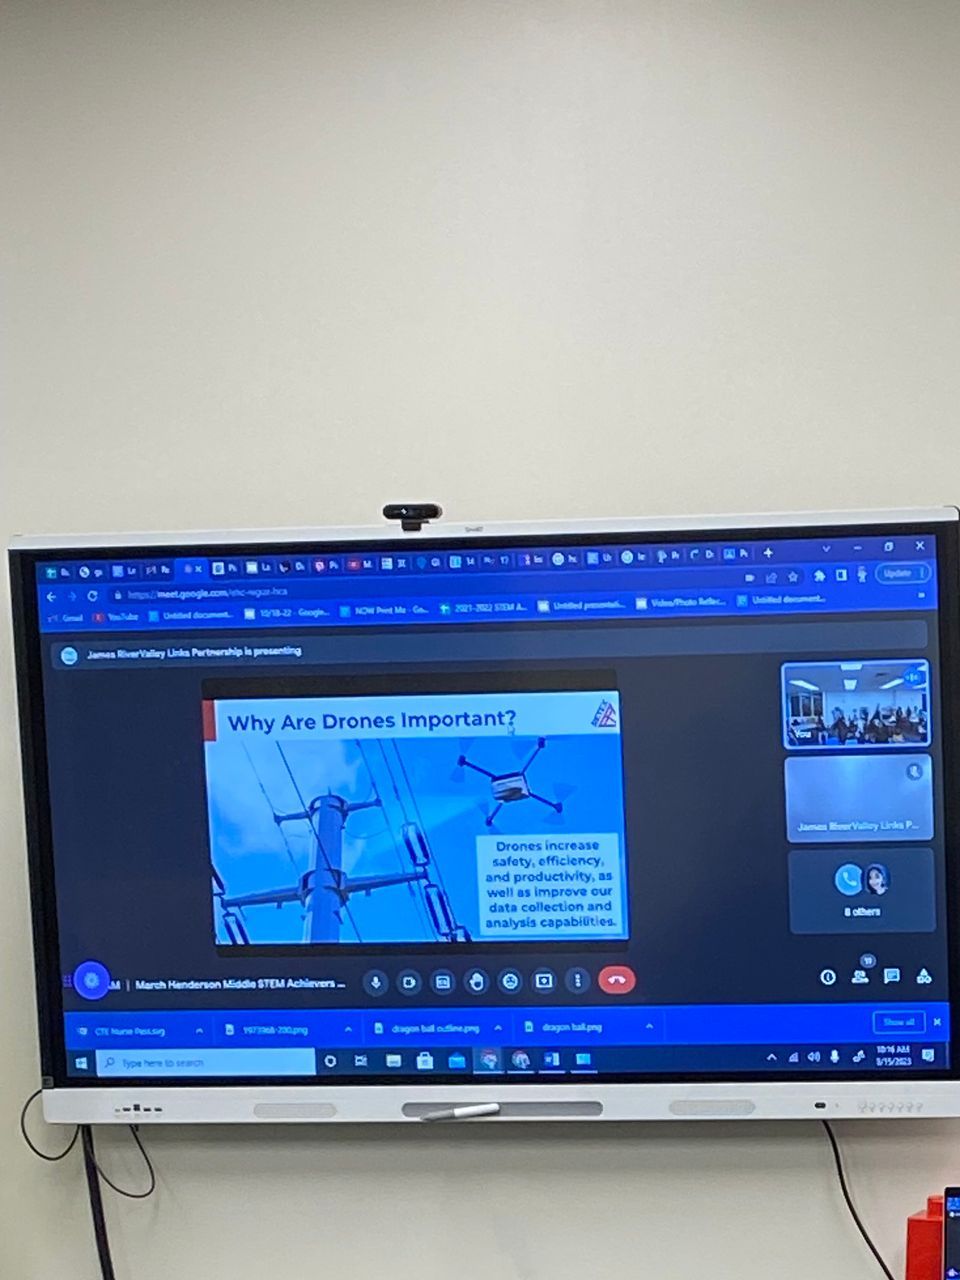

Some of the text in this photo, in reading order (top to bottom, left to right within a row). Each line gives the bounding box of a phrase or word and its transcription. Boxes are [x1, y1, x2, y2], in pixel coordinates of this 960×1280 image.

[108, 612, 139, 621] YouTube
[86, 646, 302, 660] James RiverValley Links Partnership is presenting
[227, 708, 516, 735] Why Are Drones Important?
[795, 729, 811, 738] You
[797, 822, 827, 832] James
[880, 820, 904, 830] Links
[496, 839, 599, 852] Drones increase
[493, 855, 604, 869] safety, efficiency,
[486, 871, 613, 884] and productivity, as
[487, 886, 613, 898] well as improve our
[489, 900, 612, 913] data collection and
[852, 907, 881, 917] others
[486, 915, 617, 930] analysis capabilities.
[135, 979, 166, 990] March
[168, 979, 222, 990] Henderson
[223, 978, 256, 989] Middle
[258, 978, 285, 989] STEM
[287, 977, 335, 989] Achievers
[392, 1024, 419, 1035] dragon
[542, 1022, 571, 1034] dragon
[122, 1057, 203, 1069] Type here to search
